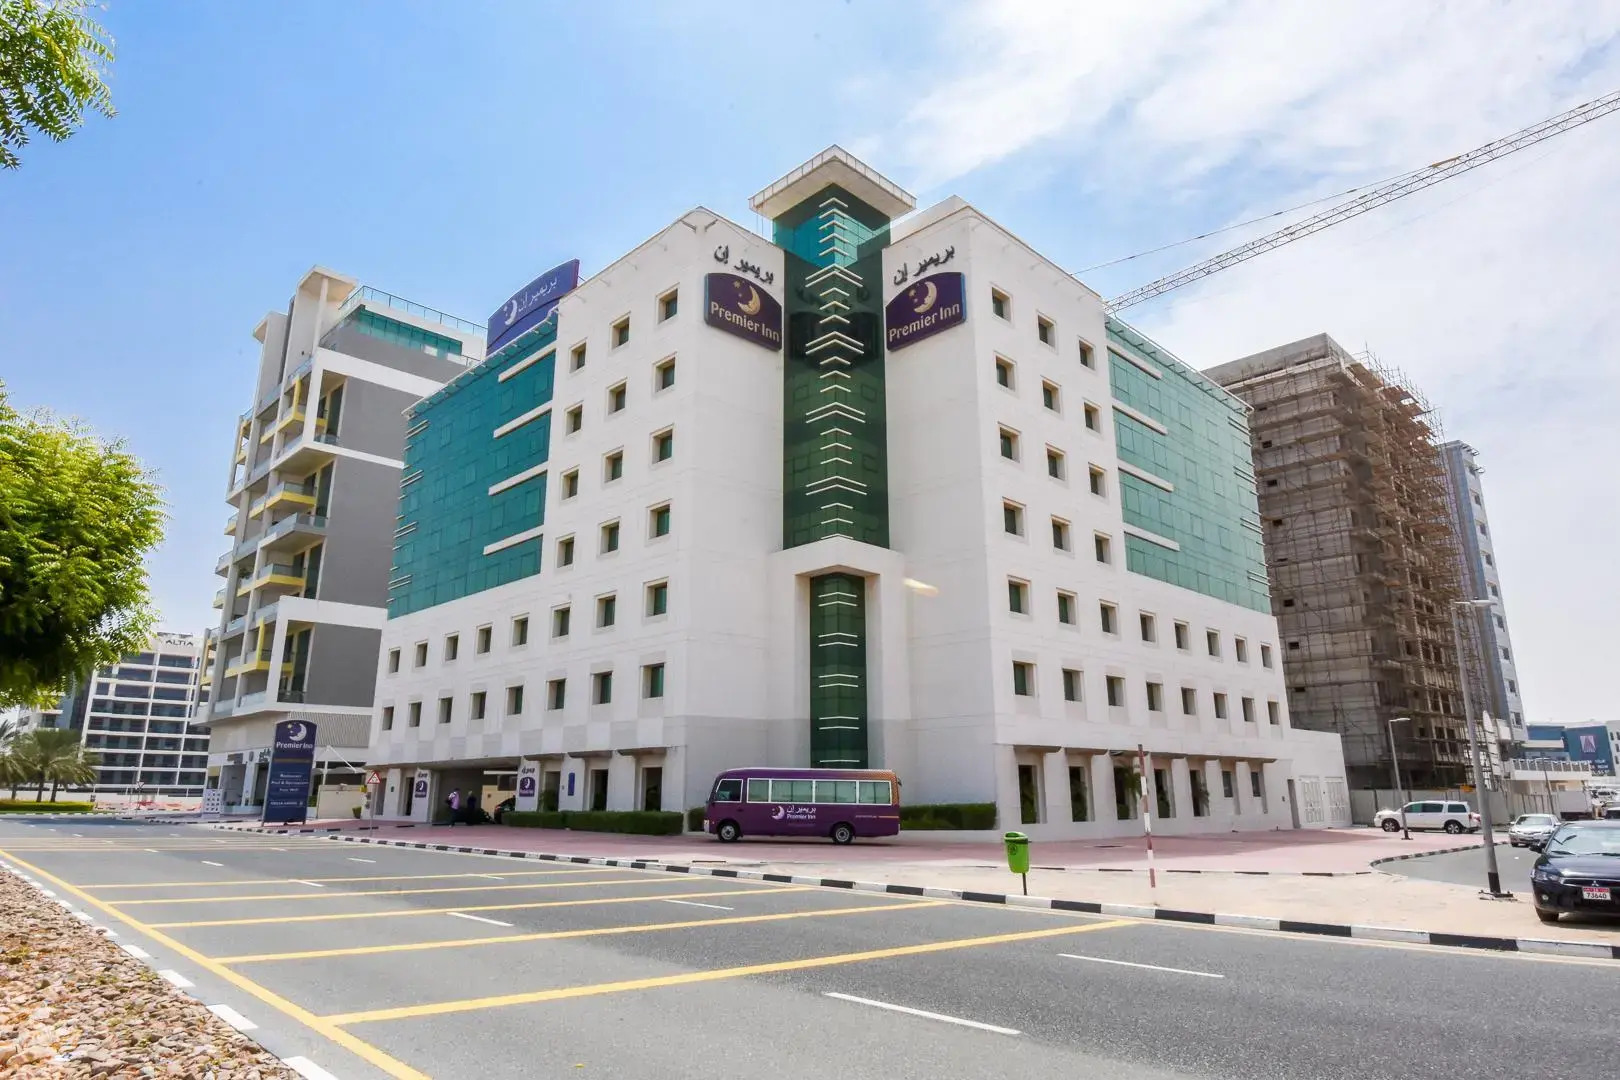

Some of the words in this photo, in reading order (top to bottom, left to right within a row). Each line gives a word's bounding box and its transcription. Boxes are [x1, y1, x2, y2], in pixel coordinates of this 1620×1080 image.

[710, 301, 760, 333] Premier
[761, 323, 780, 343] Inn
[888, 312, 938, 343] Premier
[939, 302, 960, 320] Inn
[276, 741, 303, 749] Premier
